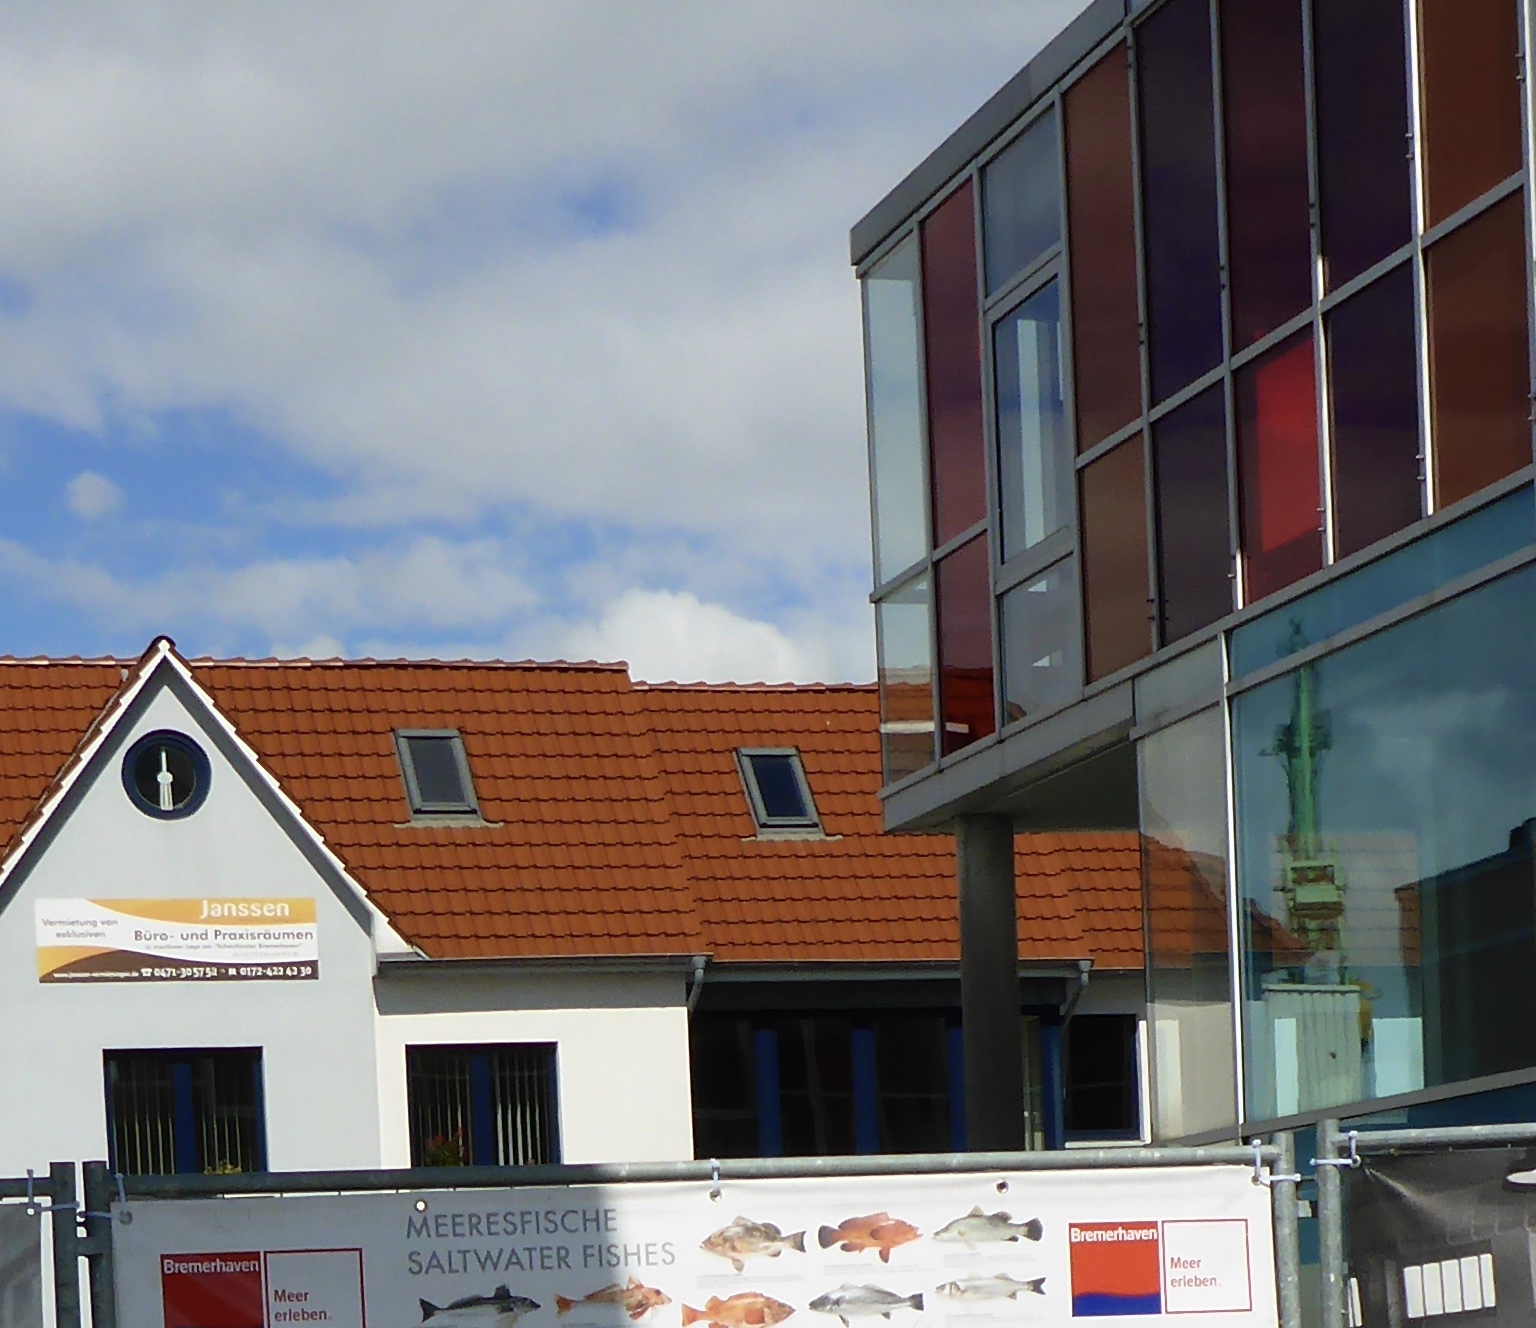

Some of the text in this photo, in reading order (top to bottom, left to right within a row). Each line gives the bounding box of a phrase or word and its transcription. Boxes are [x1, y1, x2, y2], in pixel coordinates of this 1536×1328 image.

[200, 899, 290, 920] Janssen
[100, 919, 119, 927] von
[134, 928, 314, 942] Büro- und Praxisräumen
[405, 1208, 618, 1241] MEERESFISCHE
[1070, 1226, 1158, 1243] Bremerhaven
[163, 1258, 260, 1277] Bremerhaven
[407, 1242, 676, 1276] SALTWATER FISHES
[1170, 1257, 1202, 1270] Meer
[273, 1289, 310, 1304] Meer
